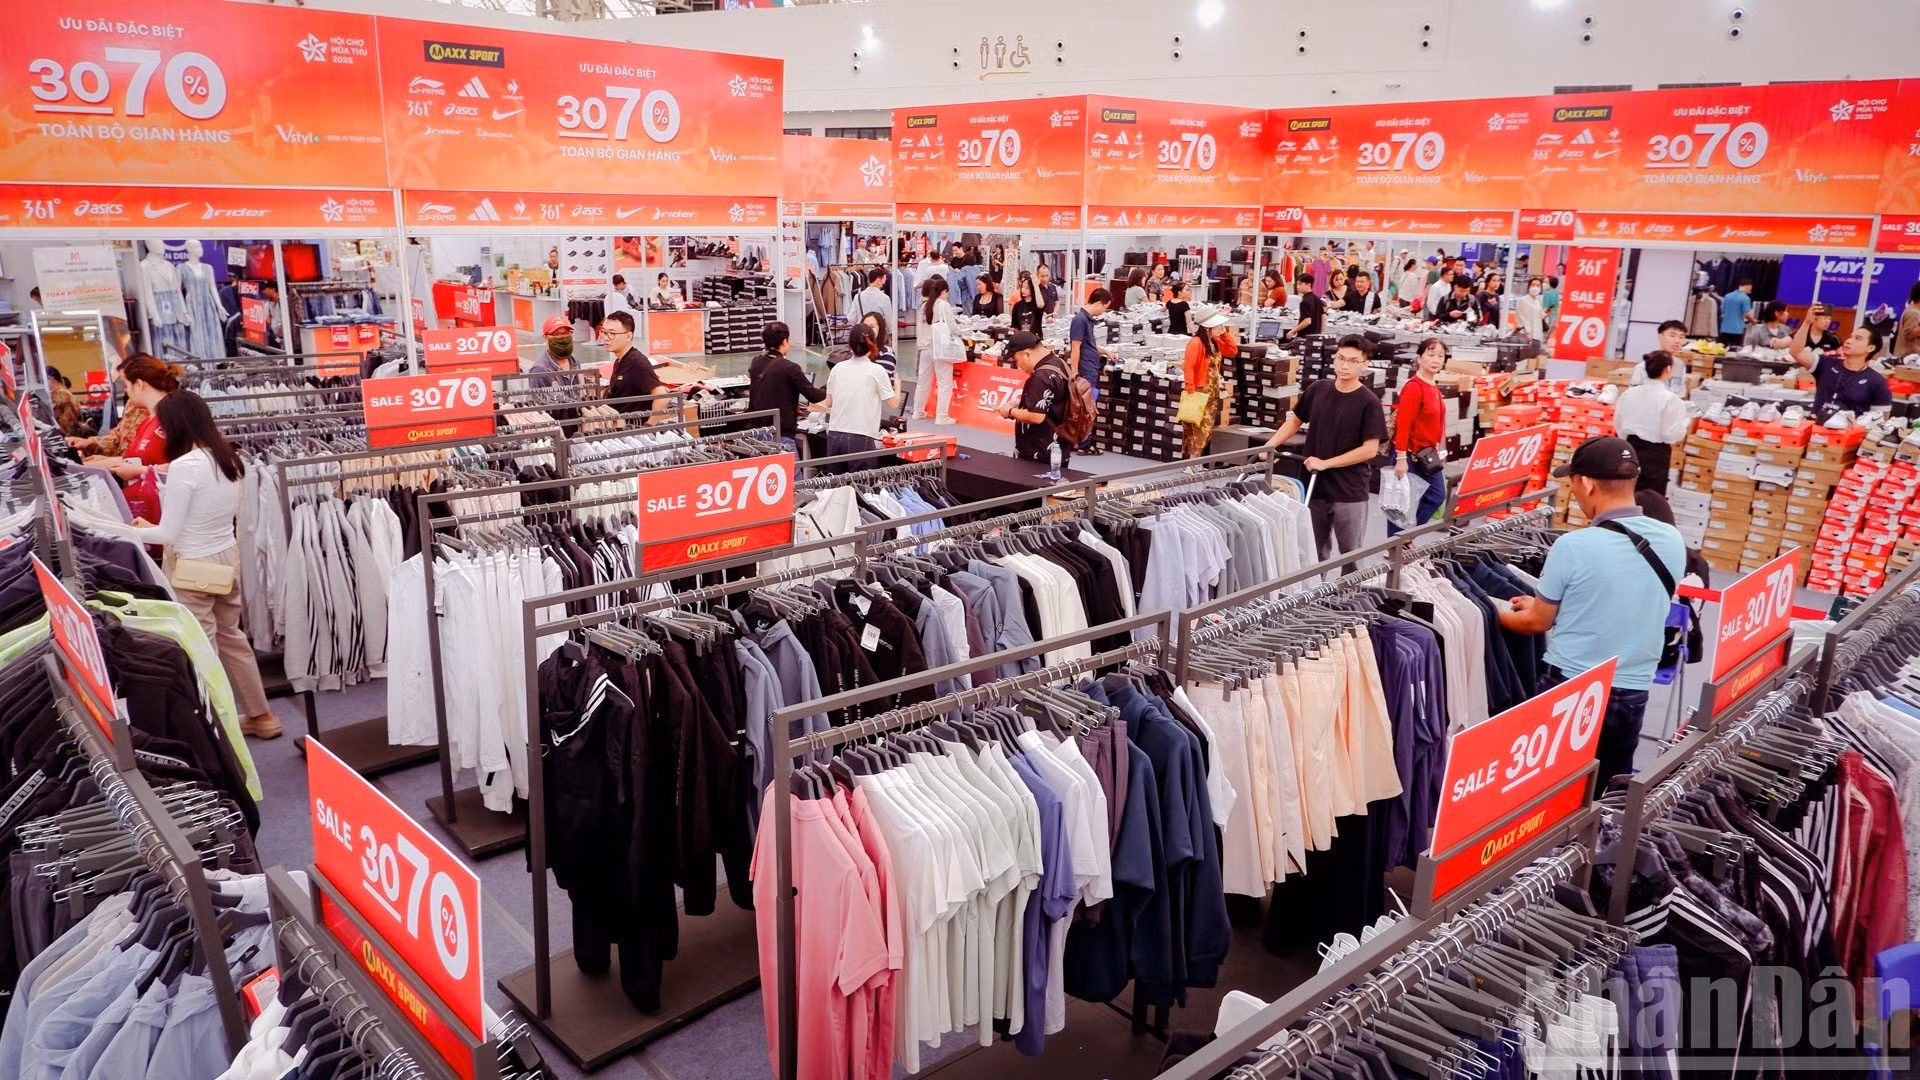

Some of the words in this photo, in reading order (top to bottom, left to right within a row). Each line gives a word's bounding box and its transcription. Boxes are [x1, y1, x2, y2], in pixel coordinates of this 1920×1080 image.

[59, 17, 83, 31] ƯU
[86, 18, 113, 33] ĐÃI
[116, 21, 148, 36] ĐẶC
[152, 24, 184, 40] BIỆT
[332, 56, 354, 64] 2025
[351, 48, 368, 56] THU
[469, 49, 500, 62] SPORT
[579, 62, 594, 74] ƯU
[596, 64, 612, 76] ĐÃI
[612, 65, 634, 79] ĐẶC
[635, 67, 657, 80] BIỆT
[1585, 109, 1609, 118] SPORT
[37, 122, 94, 139] TOÀN
[98, 123, 126, 141] BỘ
[129, 127, 172, 141] GIAN
[178, 126, 231, 144] HÀNG
[560, 145, 594, 158] TOÀN
[597, 146, 614, 161] BỘ
[617, 148, 646, 160] GIAN
[648, 147, 681, 162] HÀNG
[1695, 174, 1724, 183] GIAN
[1726, 172, 1760, 184] HÀNG
[1570, 290, 1605, 304] SALE
[428, 342, 452, 351] SALE
[371, 395, 403, 408] SALE
[435, 426, 458, 438] SPORT
[1472, 456, 1493, 470] SALE
[646, 494, 687, 512] SALE
[687, 539, 720, 559] MAXX
[721, 535, 747, 550] SPORT
[1721, 615, 1742, 642] SALE
[1452, 760, 1499, 803] SALE
[316, 797, 352, 852] SALE
[1480, 827, 1517, 866] MAXX
[1517, 810, 1546, 836] SPORT
[362, 940, 396, 992] MAXX
[397, 976, 428, 1025] SPORT
